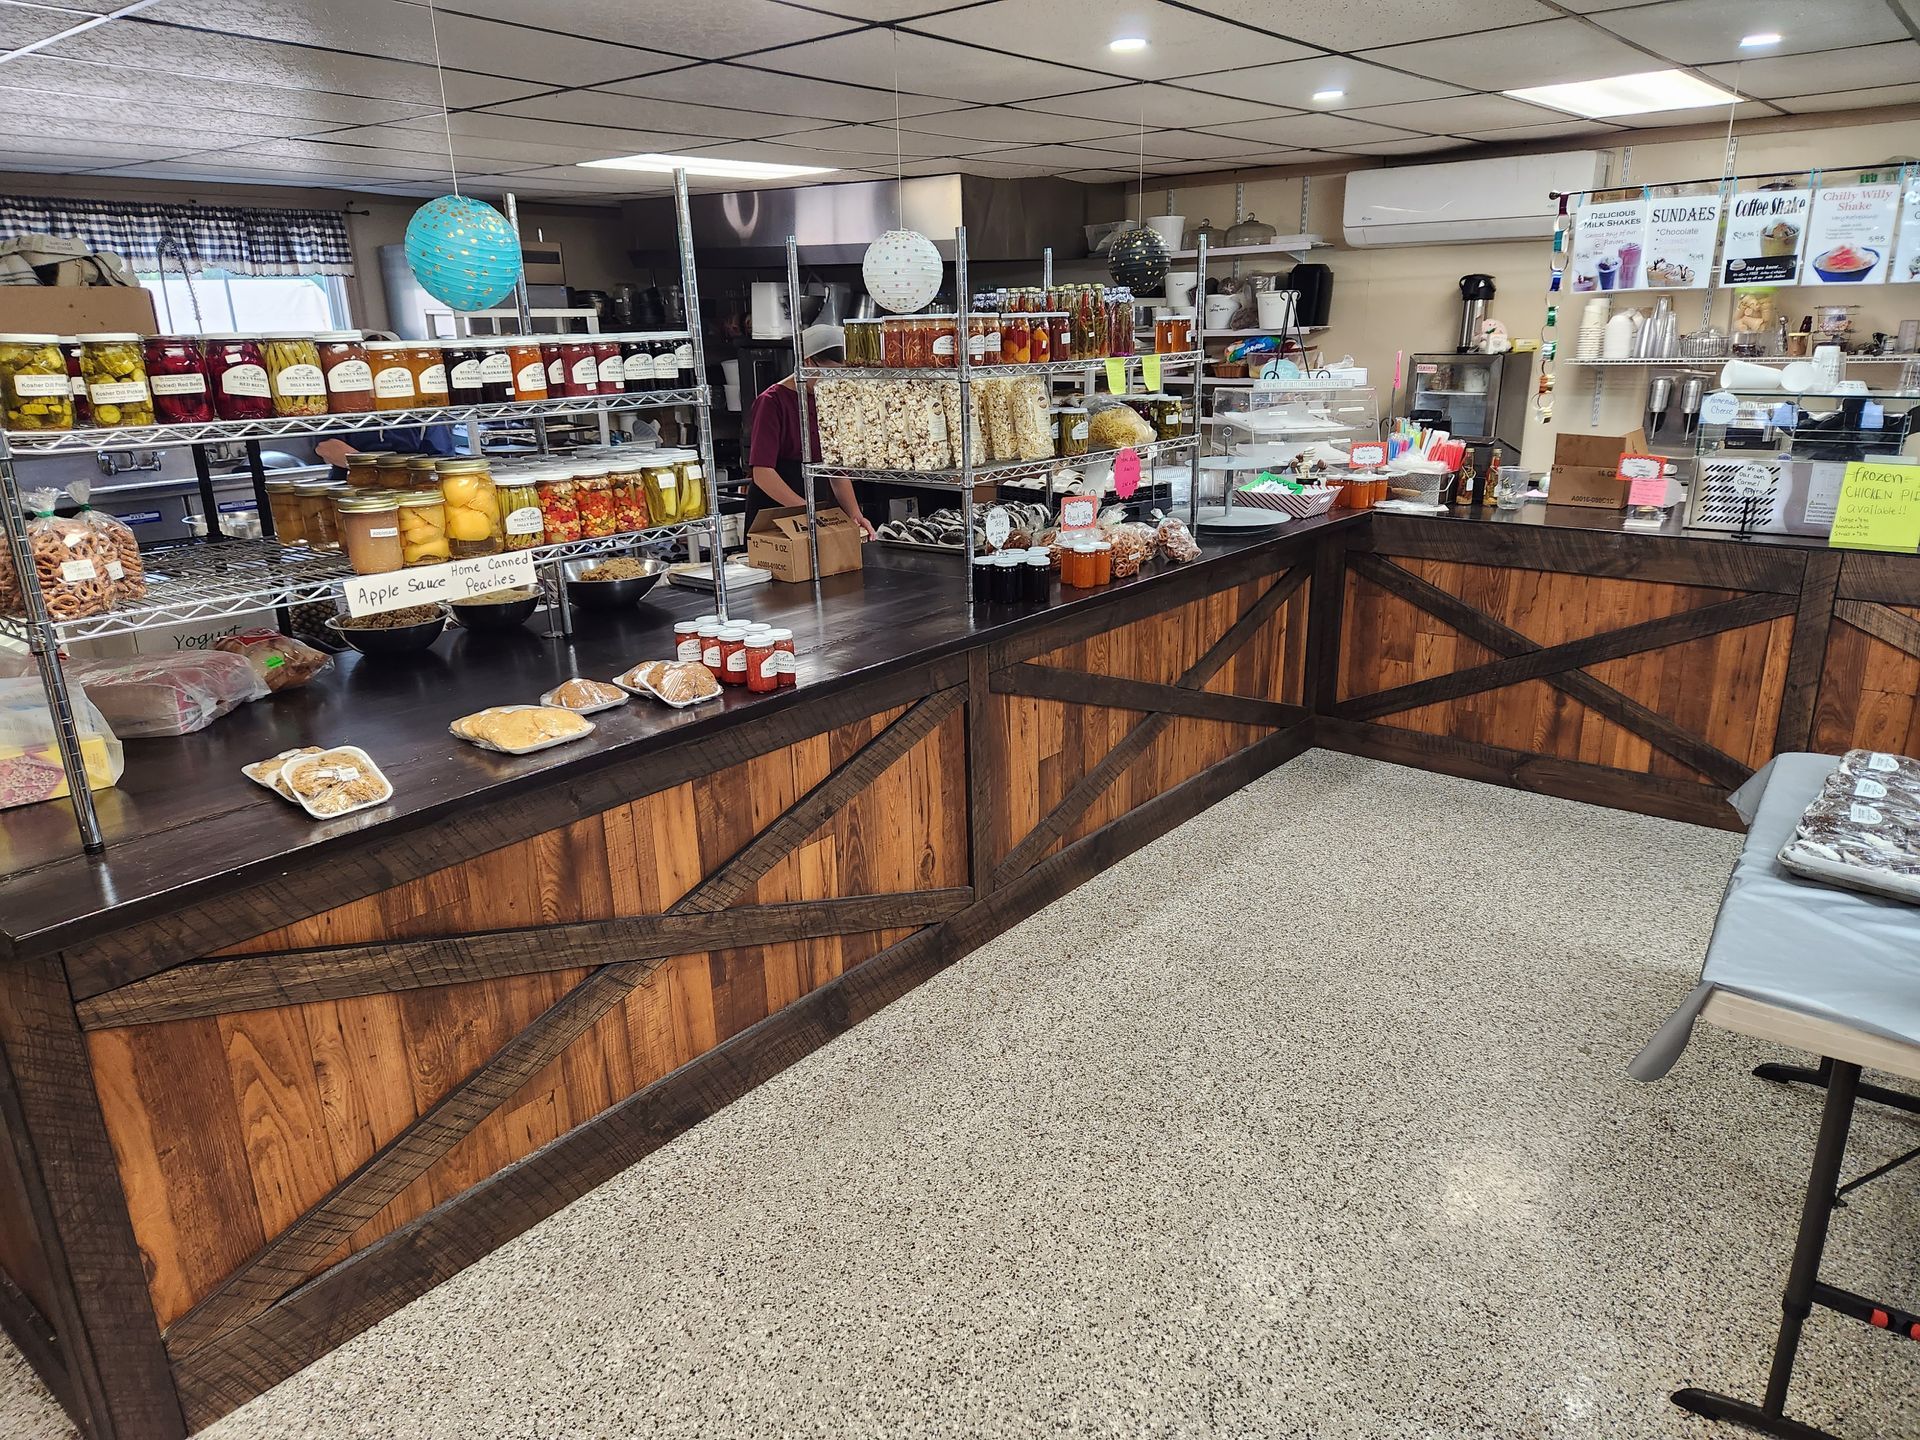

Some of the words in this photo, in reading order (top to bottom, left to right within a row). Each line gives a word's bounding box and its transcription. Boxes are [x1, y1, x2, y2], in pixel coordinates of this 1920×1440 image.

[1651, 206, 1716, 223] SUNDAES
[1735, 198, 1769, 217] Coffee
[1769, 196, 1806, 215] Shake
[1837, 202, 1872, 211] Shake
[1606, 218, 1641, 228] SHAKES
[1660, 227, 1699, 236] Chocolate
[1845, 486, 1893, 500] CHICKEN
[450, 562, 481, 577] Home
[487, 551, 529, 570] Canned
[358, 584, 400, 607] Apple
[407, 577, 446, 592] Sauce
[465, 573, 516, 595] Peaches
[173, 624, 242, 650] Yogurt
